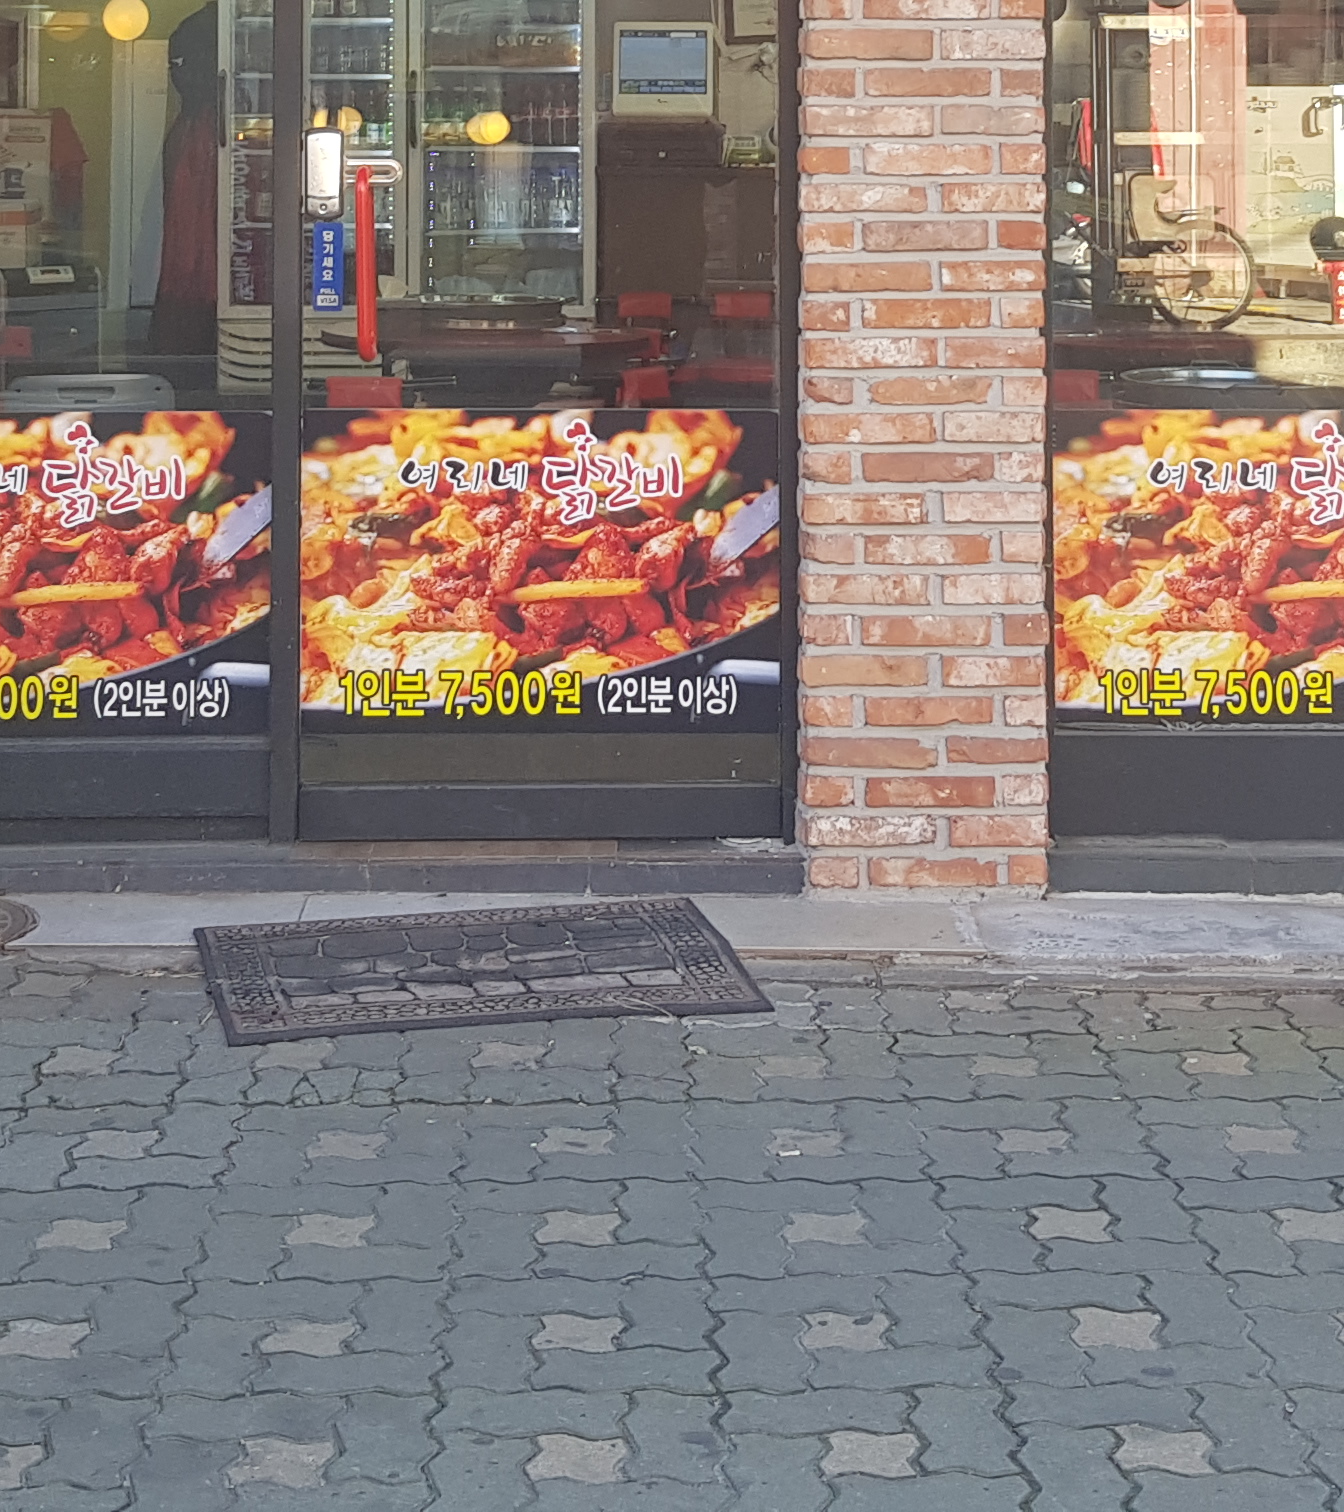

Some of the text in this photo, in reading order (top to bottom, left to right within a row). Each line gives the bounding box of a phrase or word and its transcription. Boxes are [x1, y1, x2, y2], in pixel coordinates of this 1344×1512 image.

[41, 453, 186, 528] 닭갈비
[397, 451, 684, 525] 여리네 닭갈비
[1147, 458, 1278, 493] 여리네
[93, 678, 167, 720] (2인분
[171, 678, 230, 720] 이상)
[338, 669, 738, 722] 1인분 7,500원 (2인분 이상)
[1099, 668, 1186, 719] 1인분
[1195, 669, 1334, 721] 7,500원
